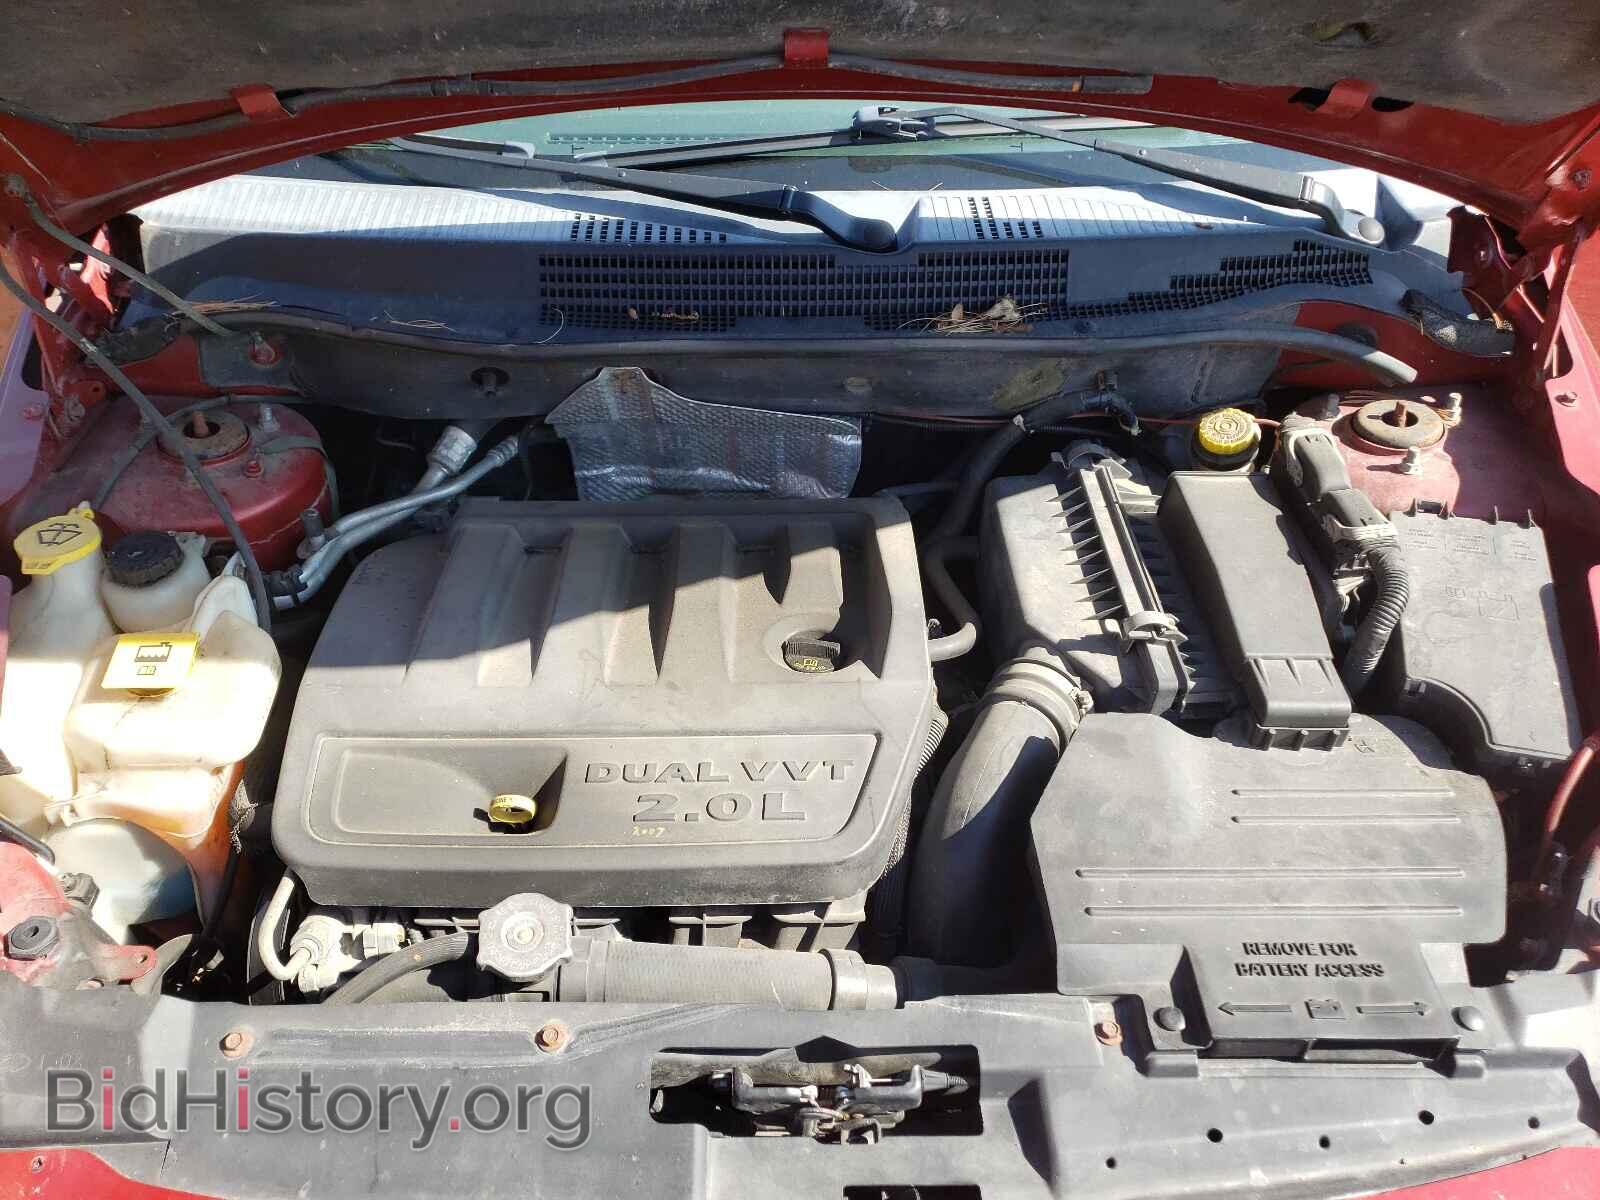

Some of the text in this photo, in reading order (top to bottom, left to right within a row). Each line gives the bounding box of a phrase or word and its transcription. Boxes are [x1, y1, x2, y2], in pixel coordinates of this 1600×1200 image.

[585, 759, 856, 783] DUAL VVT
[632, 792, 808, 822] 2.0L
[1242, 942, 1358, 956] REMOVE FOR
[1234, 963, 1385, 977] BATTERY ACCESS
